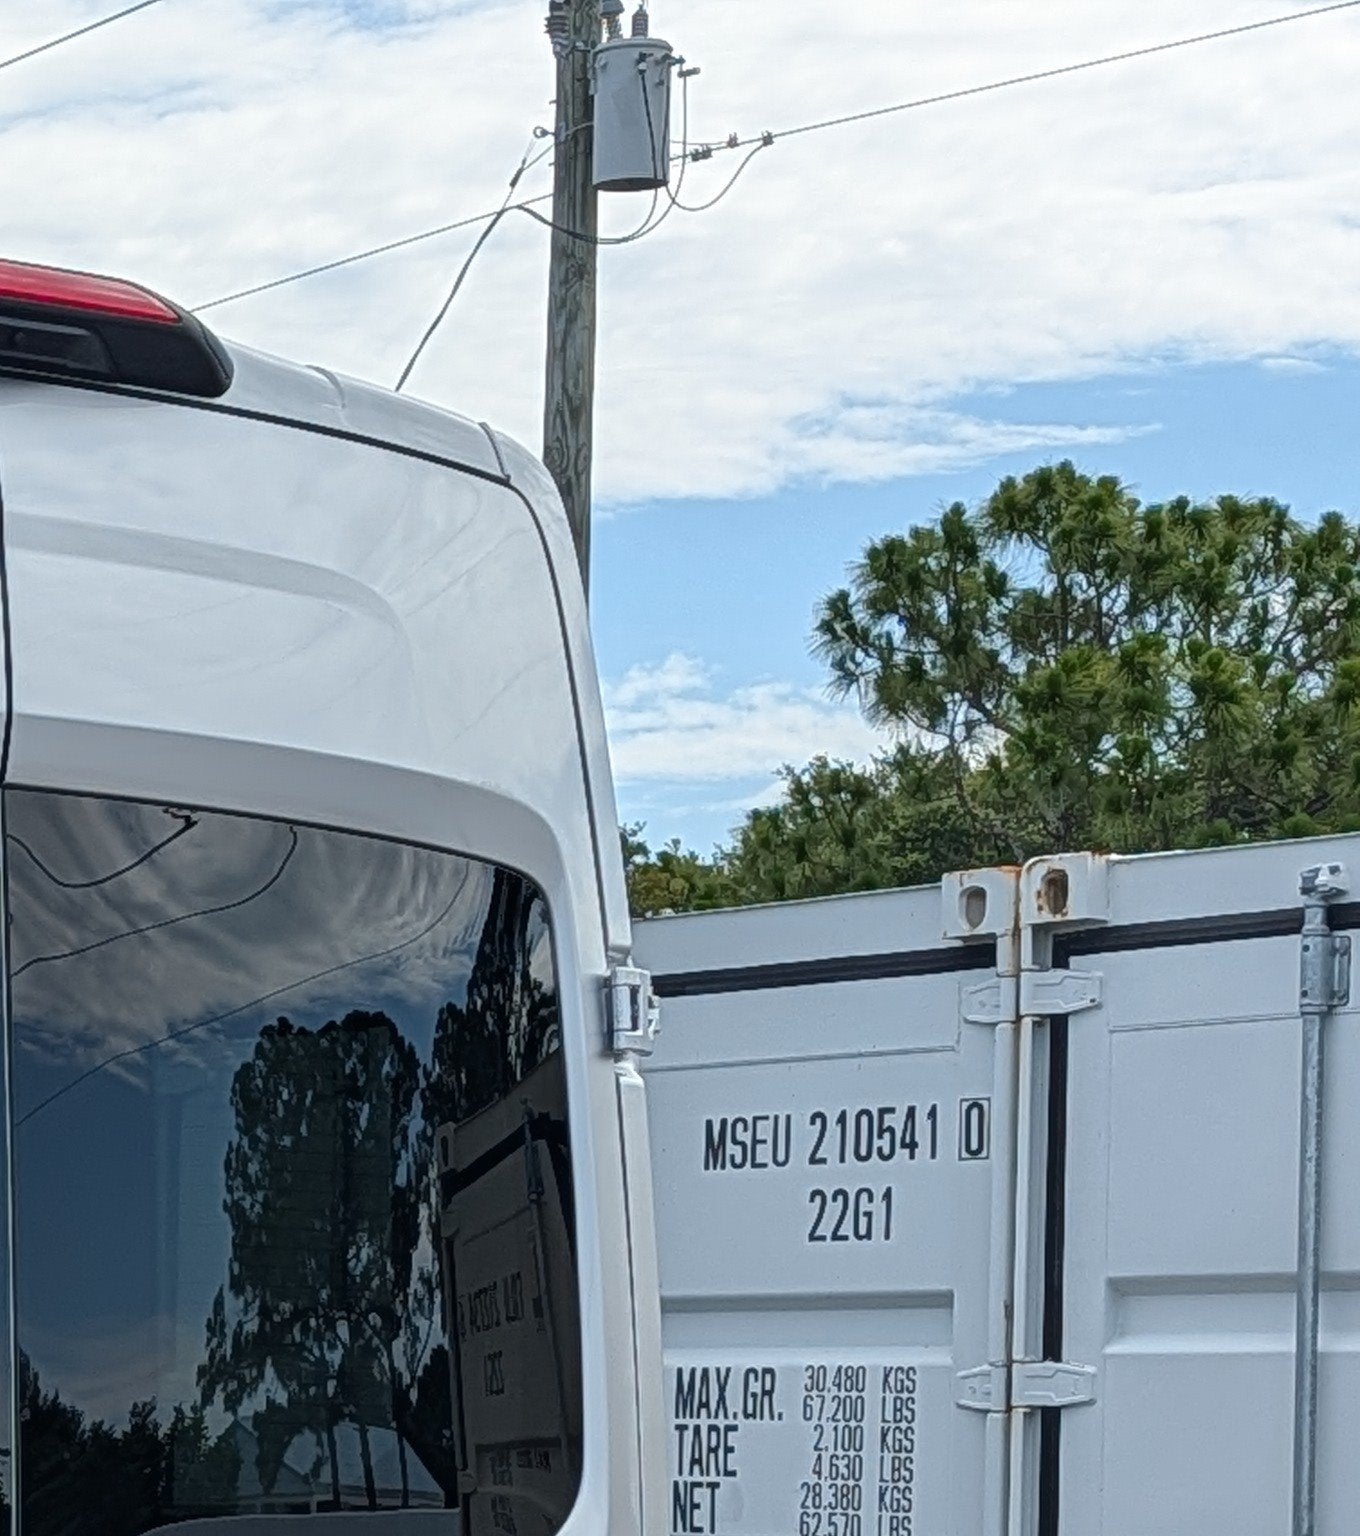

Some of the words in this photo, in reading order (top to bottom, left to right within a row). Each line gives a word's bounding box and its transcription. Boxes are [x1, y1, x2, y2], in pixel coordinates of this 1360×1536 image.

[703, 1114, 792, 1171] MSEU
[808, 1103, 938, 1165] 210541
[964, 1101, 986, 1156] 0
[808, 1186, 893, 1242] 22G1
[674, 1366, 784, 1421] MAX.GR.
[882, 1365, 918, 1394] KGS
[880, 1395, 917, 1424] LBS
[674, 1424, 740, 1477] TARE
[880, 1426, 915, 1453] KGS
[879, 1455, 915, 1484] LBS
[672, 1480, 721, 1534] NET
[878, 1485, 913, 1513] KGS
